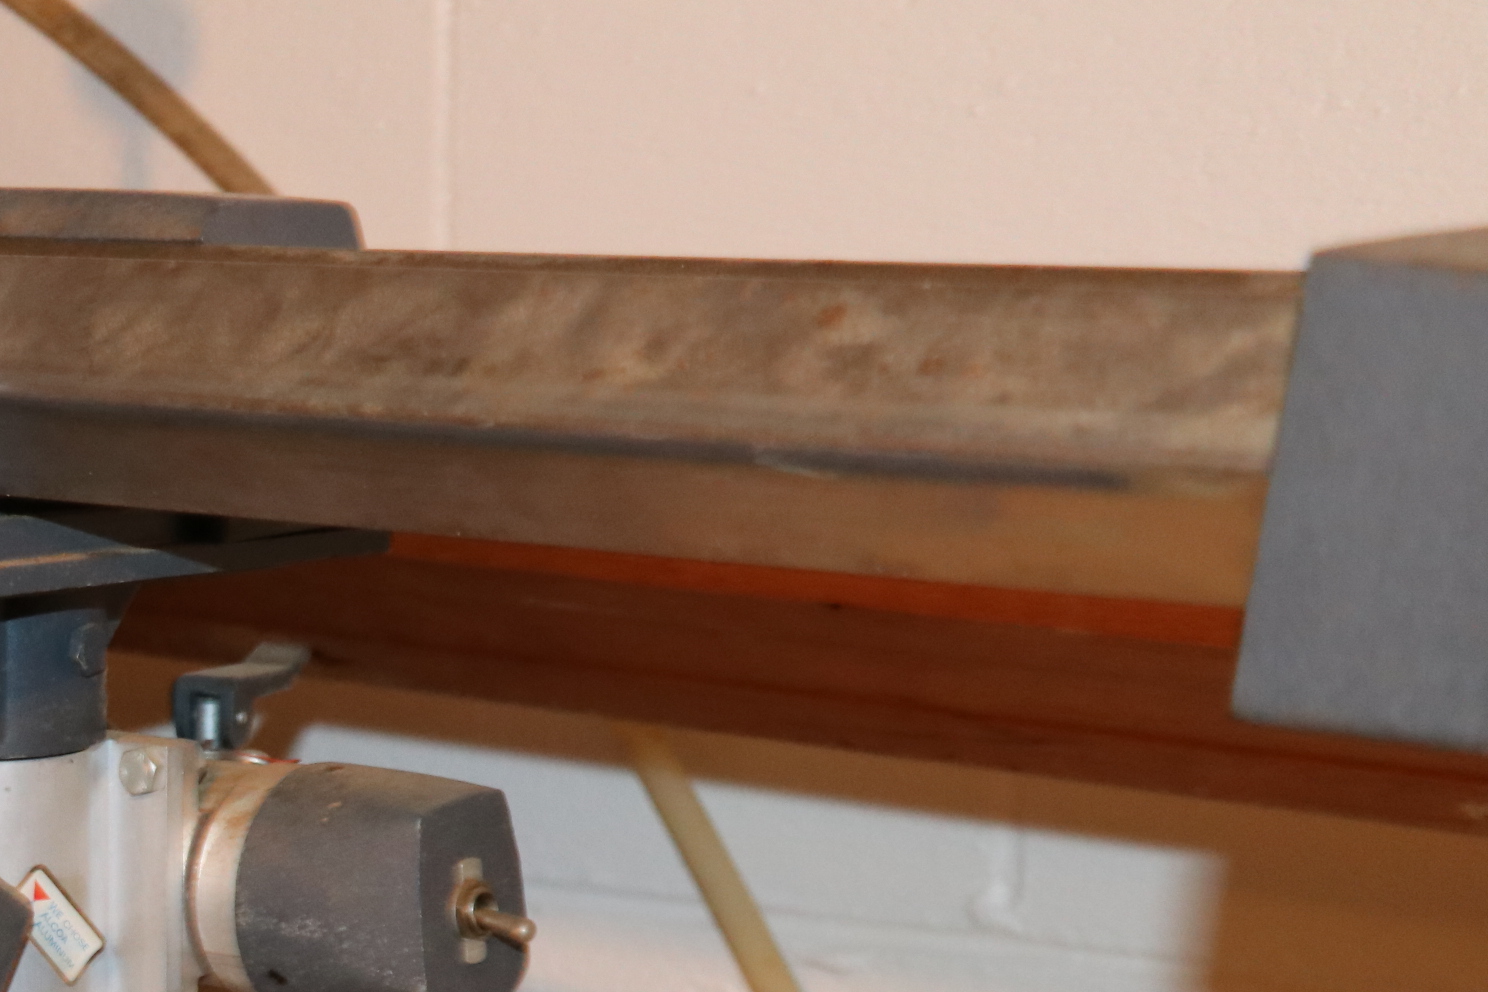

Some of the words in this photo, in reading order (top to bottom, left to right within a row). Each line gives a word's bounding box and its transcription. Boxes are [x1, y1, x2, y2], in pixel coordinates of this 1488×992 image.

[33, 921, 74, 969] ALUMINUM
[39, 912, 69, 945] ALCOA
[47, 901, 62, 919] WE
[63, 919, 90, 951] CHOSE
